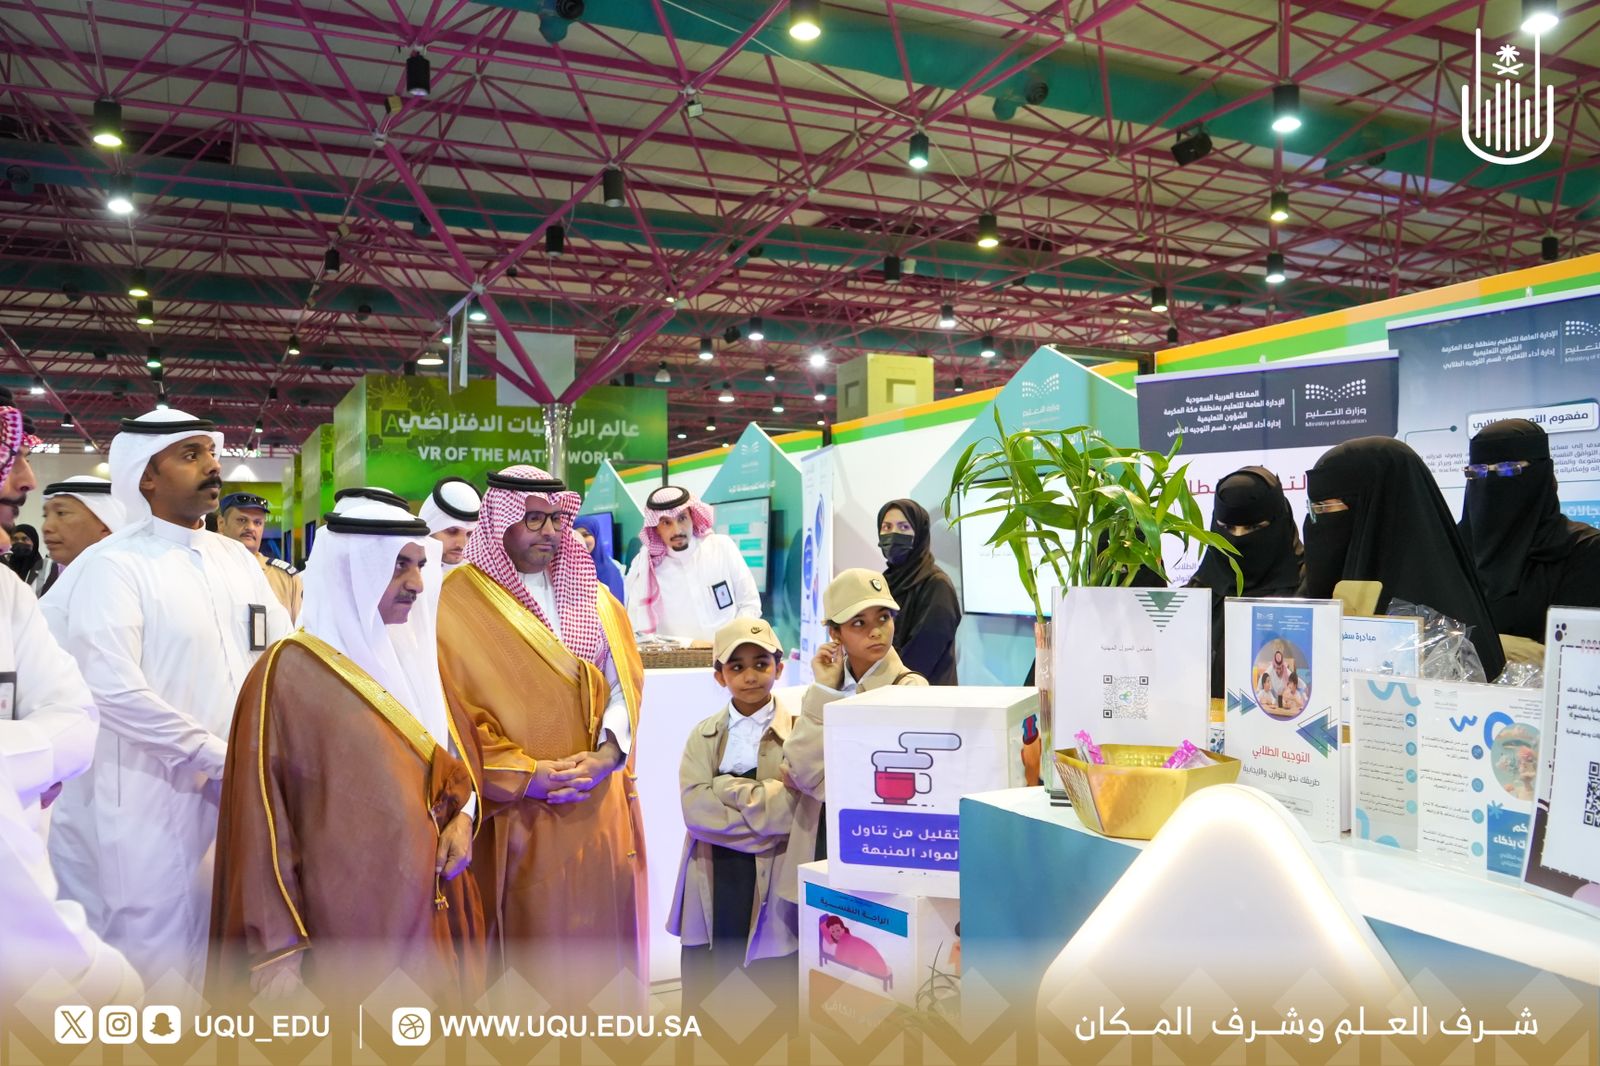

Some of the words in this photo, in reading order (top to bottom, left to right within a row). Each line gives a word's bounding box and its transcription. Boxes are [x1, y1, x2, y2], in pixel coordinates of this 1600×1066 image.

[1498, 336, 1519, 346] للتعليم
[1520, 333, 1539, 341] العامة
[1565, 342, 1600, 354] لتعليم
[1506, 352, 1527, 362] التعليم
[1186, 394, 1213, 404] السعودية
[1215, 392, 1234, 402] العربية
[1235, 389, 1259, 399] المملكة
[1223, 402, 1244, 412] للتعليم
[1245, 400, 1264, 408] العامة
[1164, 407, 1184, 416] المكرمة
[1345, 406, 1366, 416] وزارة
[398, 411, 503, 434] الافتراضي
[1197, 413, 1223, 423] التعليمية
[1549, 411, 1589, 424] مفهوم
[598, 419, 639, 440] عالم
[1190, 425, 1210, 434] التوجيه
[1211, 424, 1227, 432] قسم
[1233, 421, 1253, 431] التعليم
[418, 446, 441, 460] VR
[445, 446, 468, 461] OF
[471, 447, 503, 462] THE
[1356, 633, 1376, 642] مبادرة
[1252, 745, 1280, 759] الطلابي
[1281, 751, 1310, 764] التوجيه
[1288, 774, 1299, 783] نحو
[851, 825, 888, 836] تناول
[892, 828, 913, 839] من
[918, 829, 959, 841] تقليل
[861, 843, 916, 859] المنبهة
[920, 849, 958, 861] لمواد
[862, 911, 890, 925] الراحة
